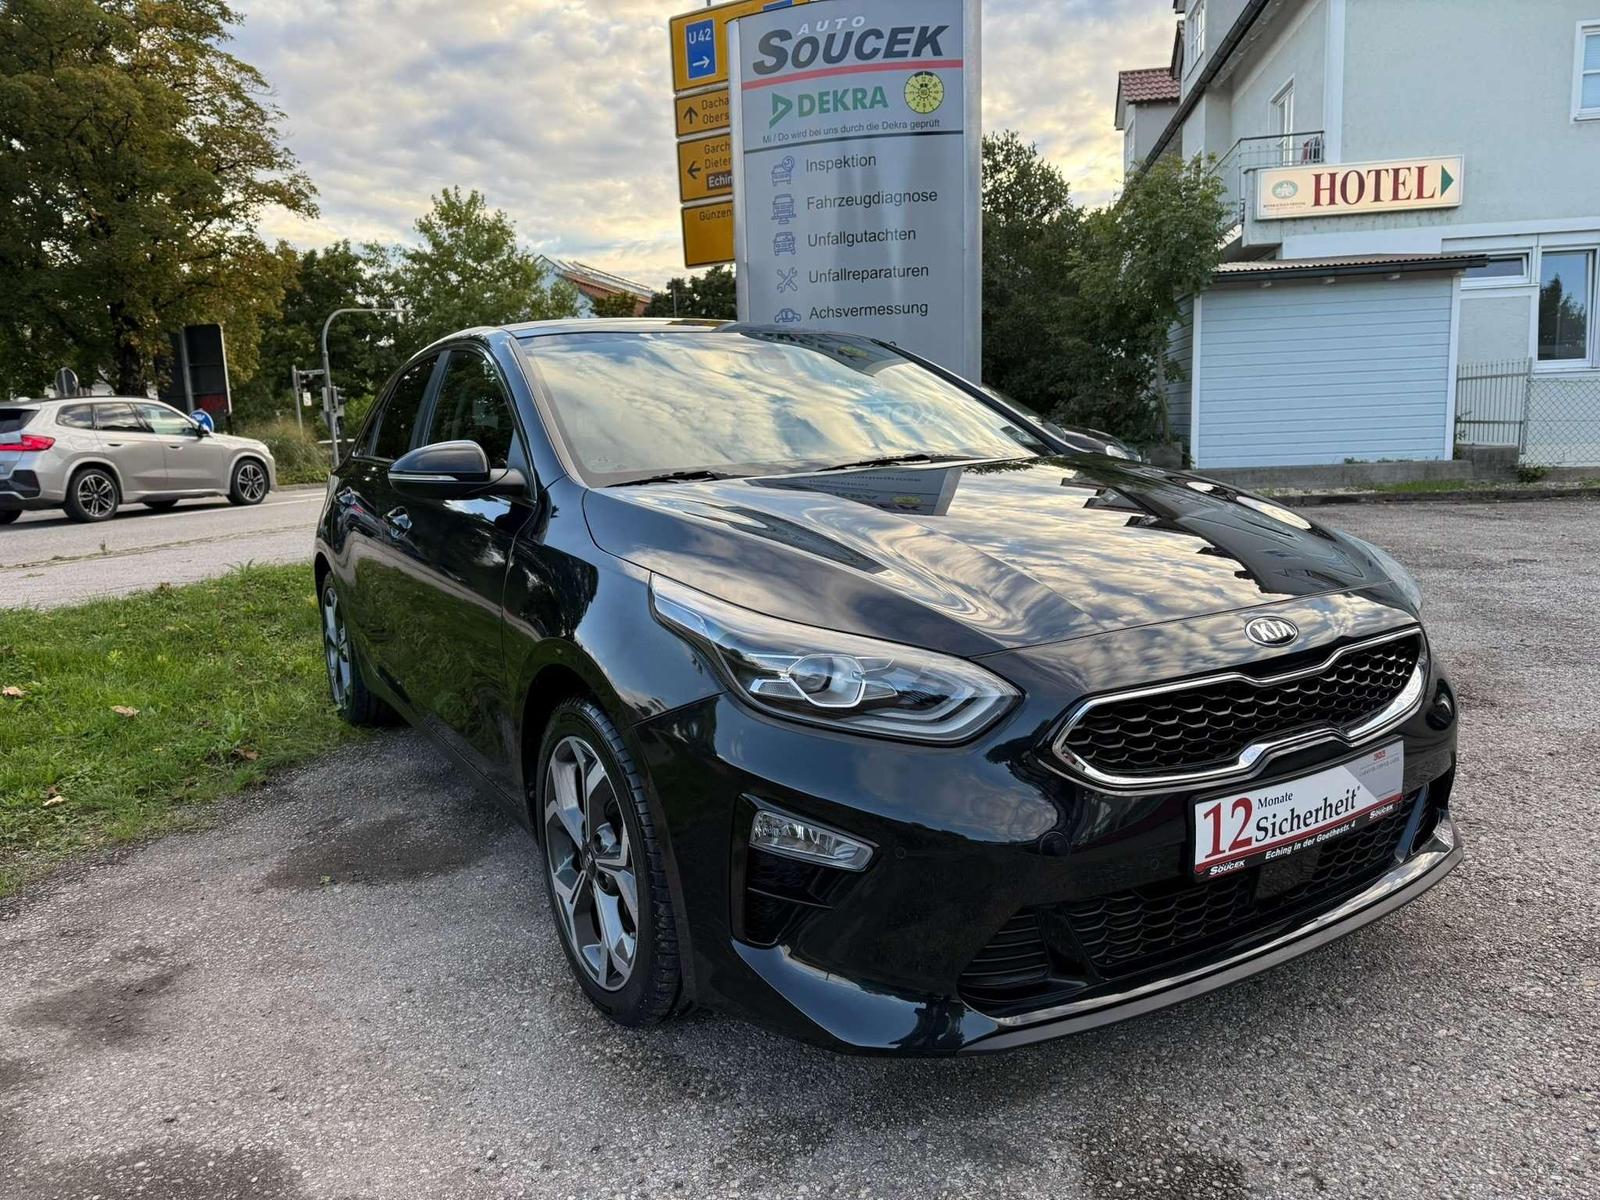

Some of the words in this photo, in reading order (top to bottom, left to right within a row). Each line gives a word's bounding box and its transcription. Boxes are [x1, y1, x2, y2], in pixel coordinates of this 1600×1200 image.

[797, 16, 866, 36] AUTO
[752, 24, 949, 75] SOUCEK
[797, 86, 889, 118] DEKRA
[809, 128, 821, 137] bei
[823, 127, 838, 135] uns
[840, 123, 864, 133] durch
[866, 122, 879, 130] die
[881, 120, 908, 129] Dekra
[910, 118, 940, 130] geprüft
[806, 155, 876, 172] Inspektion
[1311, 165, 1436, 208] HOTEL
[807, 189, 938, 210] Fahrzeugdiagnose
[807, 229, 917, 248] Unfallgutachten
[808, 265, 929, 284] Unfallreparaturen
[809, 302, 929, 321] Achsvermessung
[1257, 791, 1293, 810] Monate
[1203, 797, 1253, 858] 12
[1265, 844, 1293, 860] Eching
[1293, 842, 1301, 850] in
[1303, 837, 1315, 847] der
